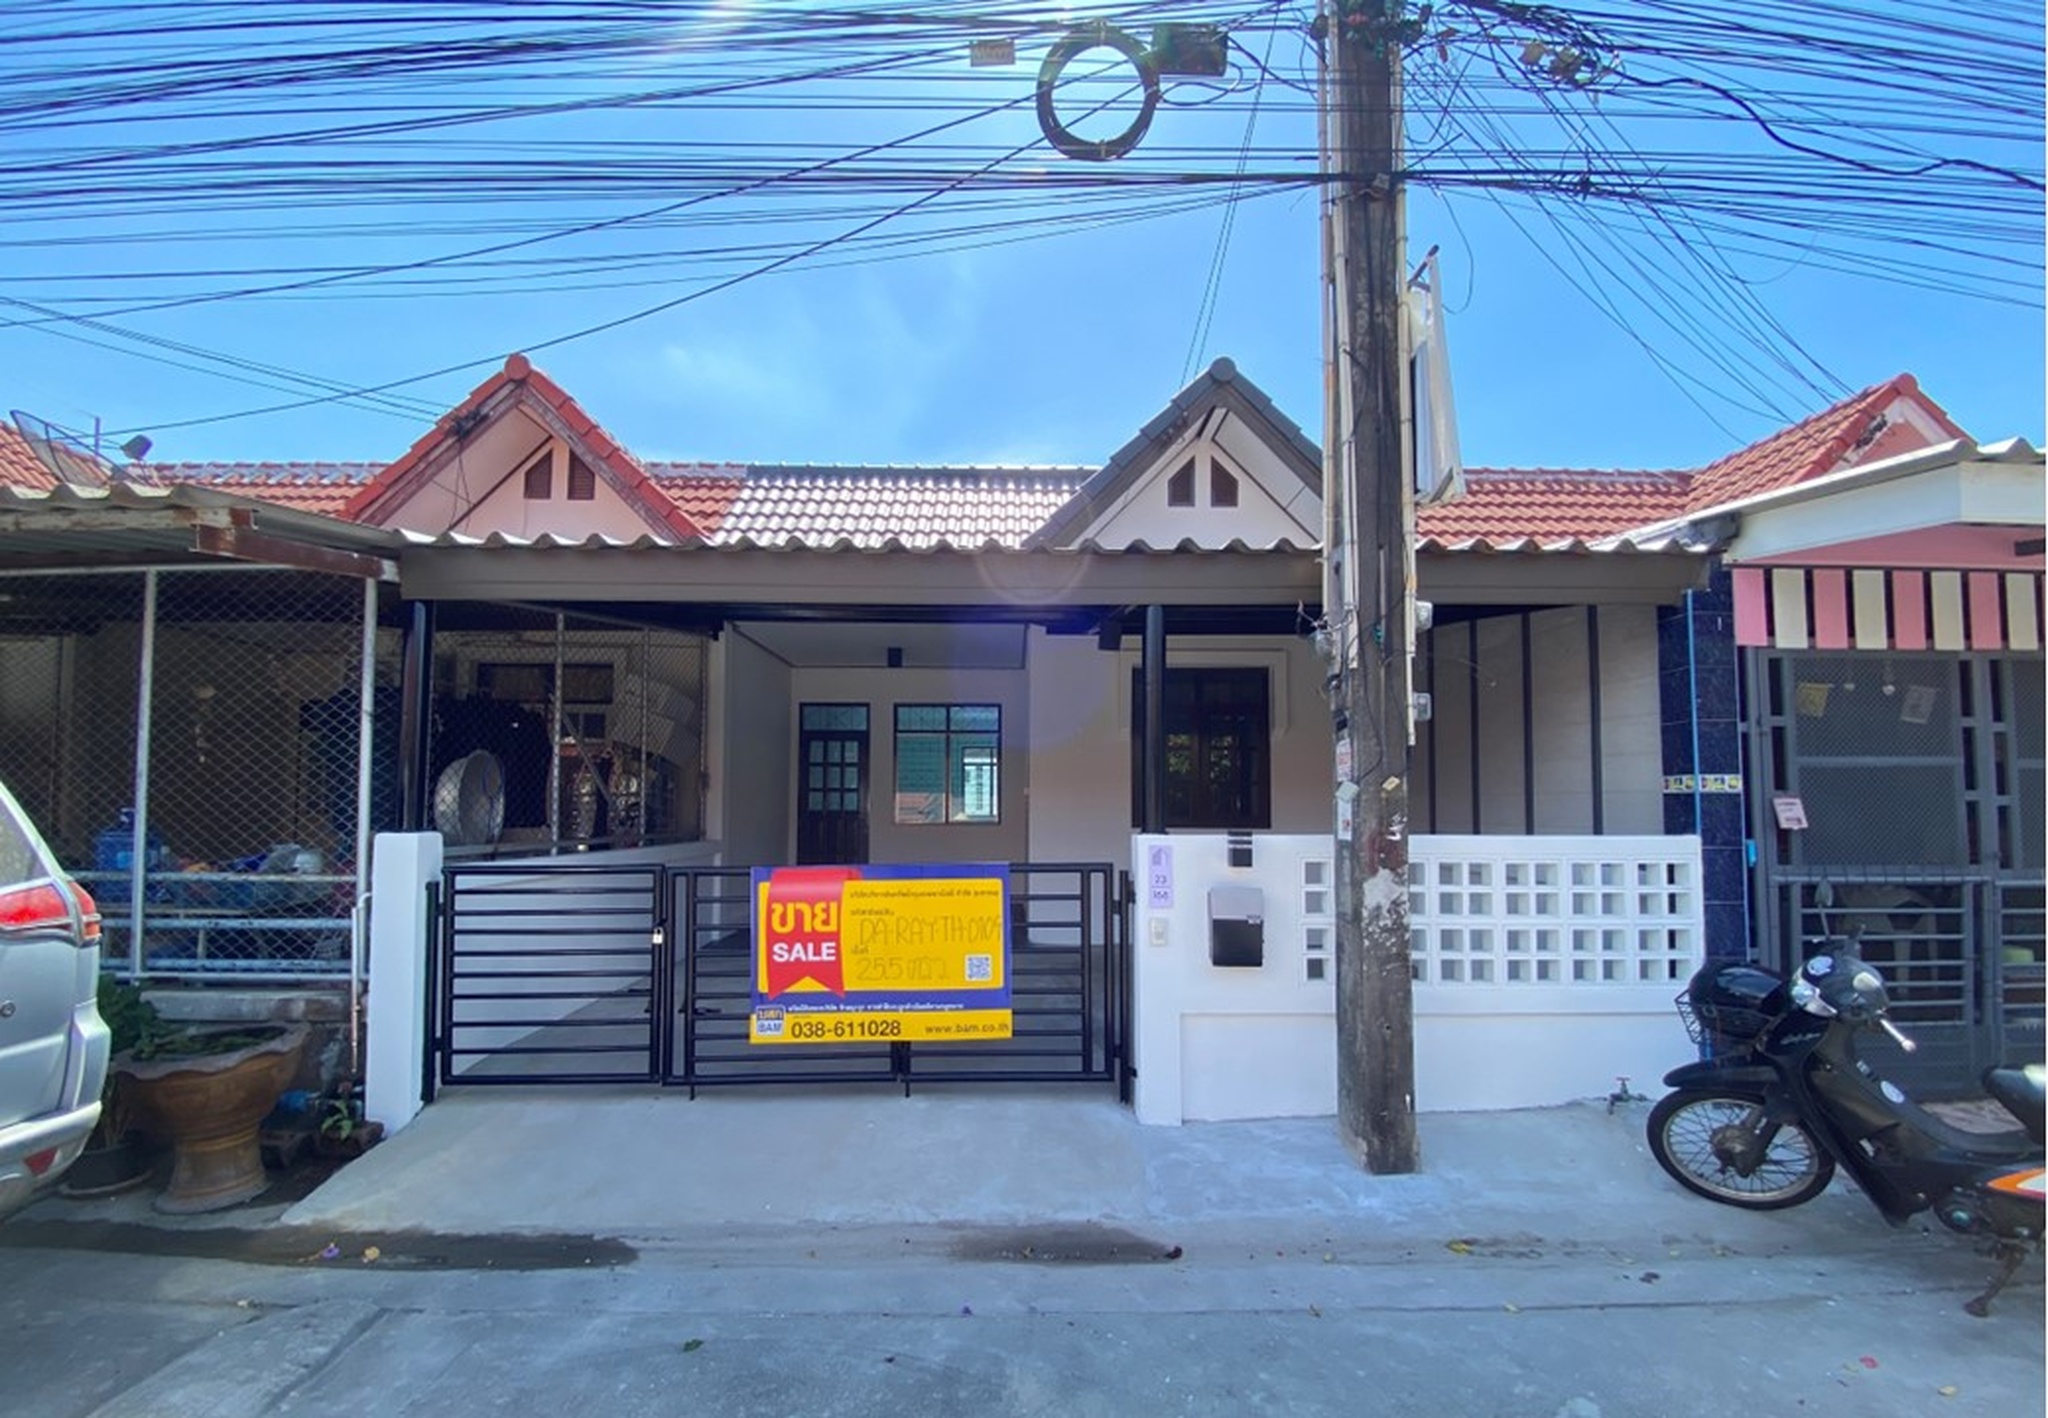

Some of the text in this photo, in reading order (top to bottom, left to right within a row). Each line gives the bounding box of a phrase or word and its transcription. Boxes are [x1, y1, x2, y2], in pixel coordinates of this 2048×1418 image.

[771, 901, 838, 934] ขาย
[773, 942, 837, 962] SALE
[791, 1020, 1009, 1038] 038-611028 www.bam.co.th
